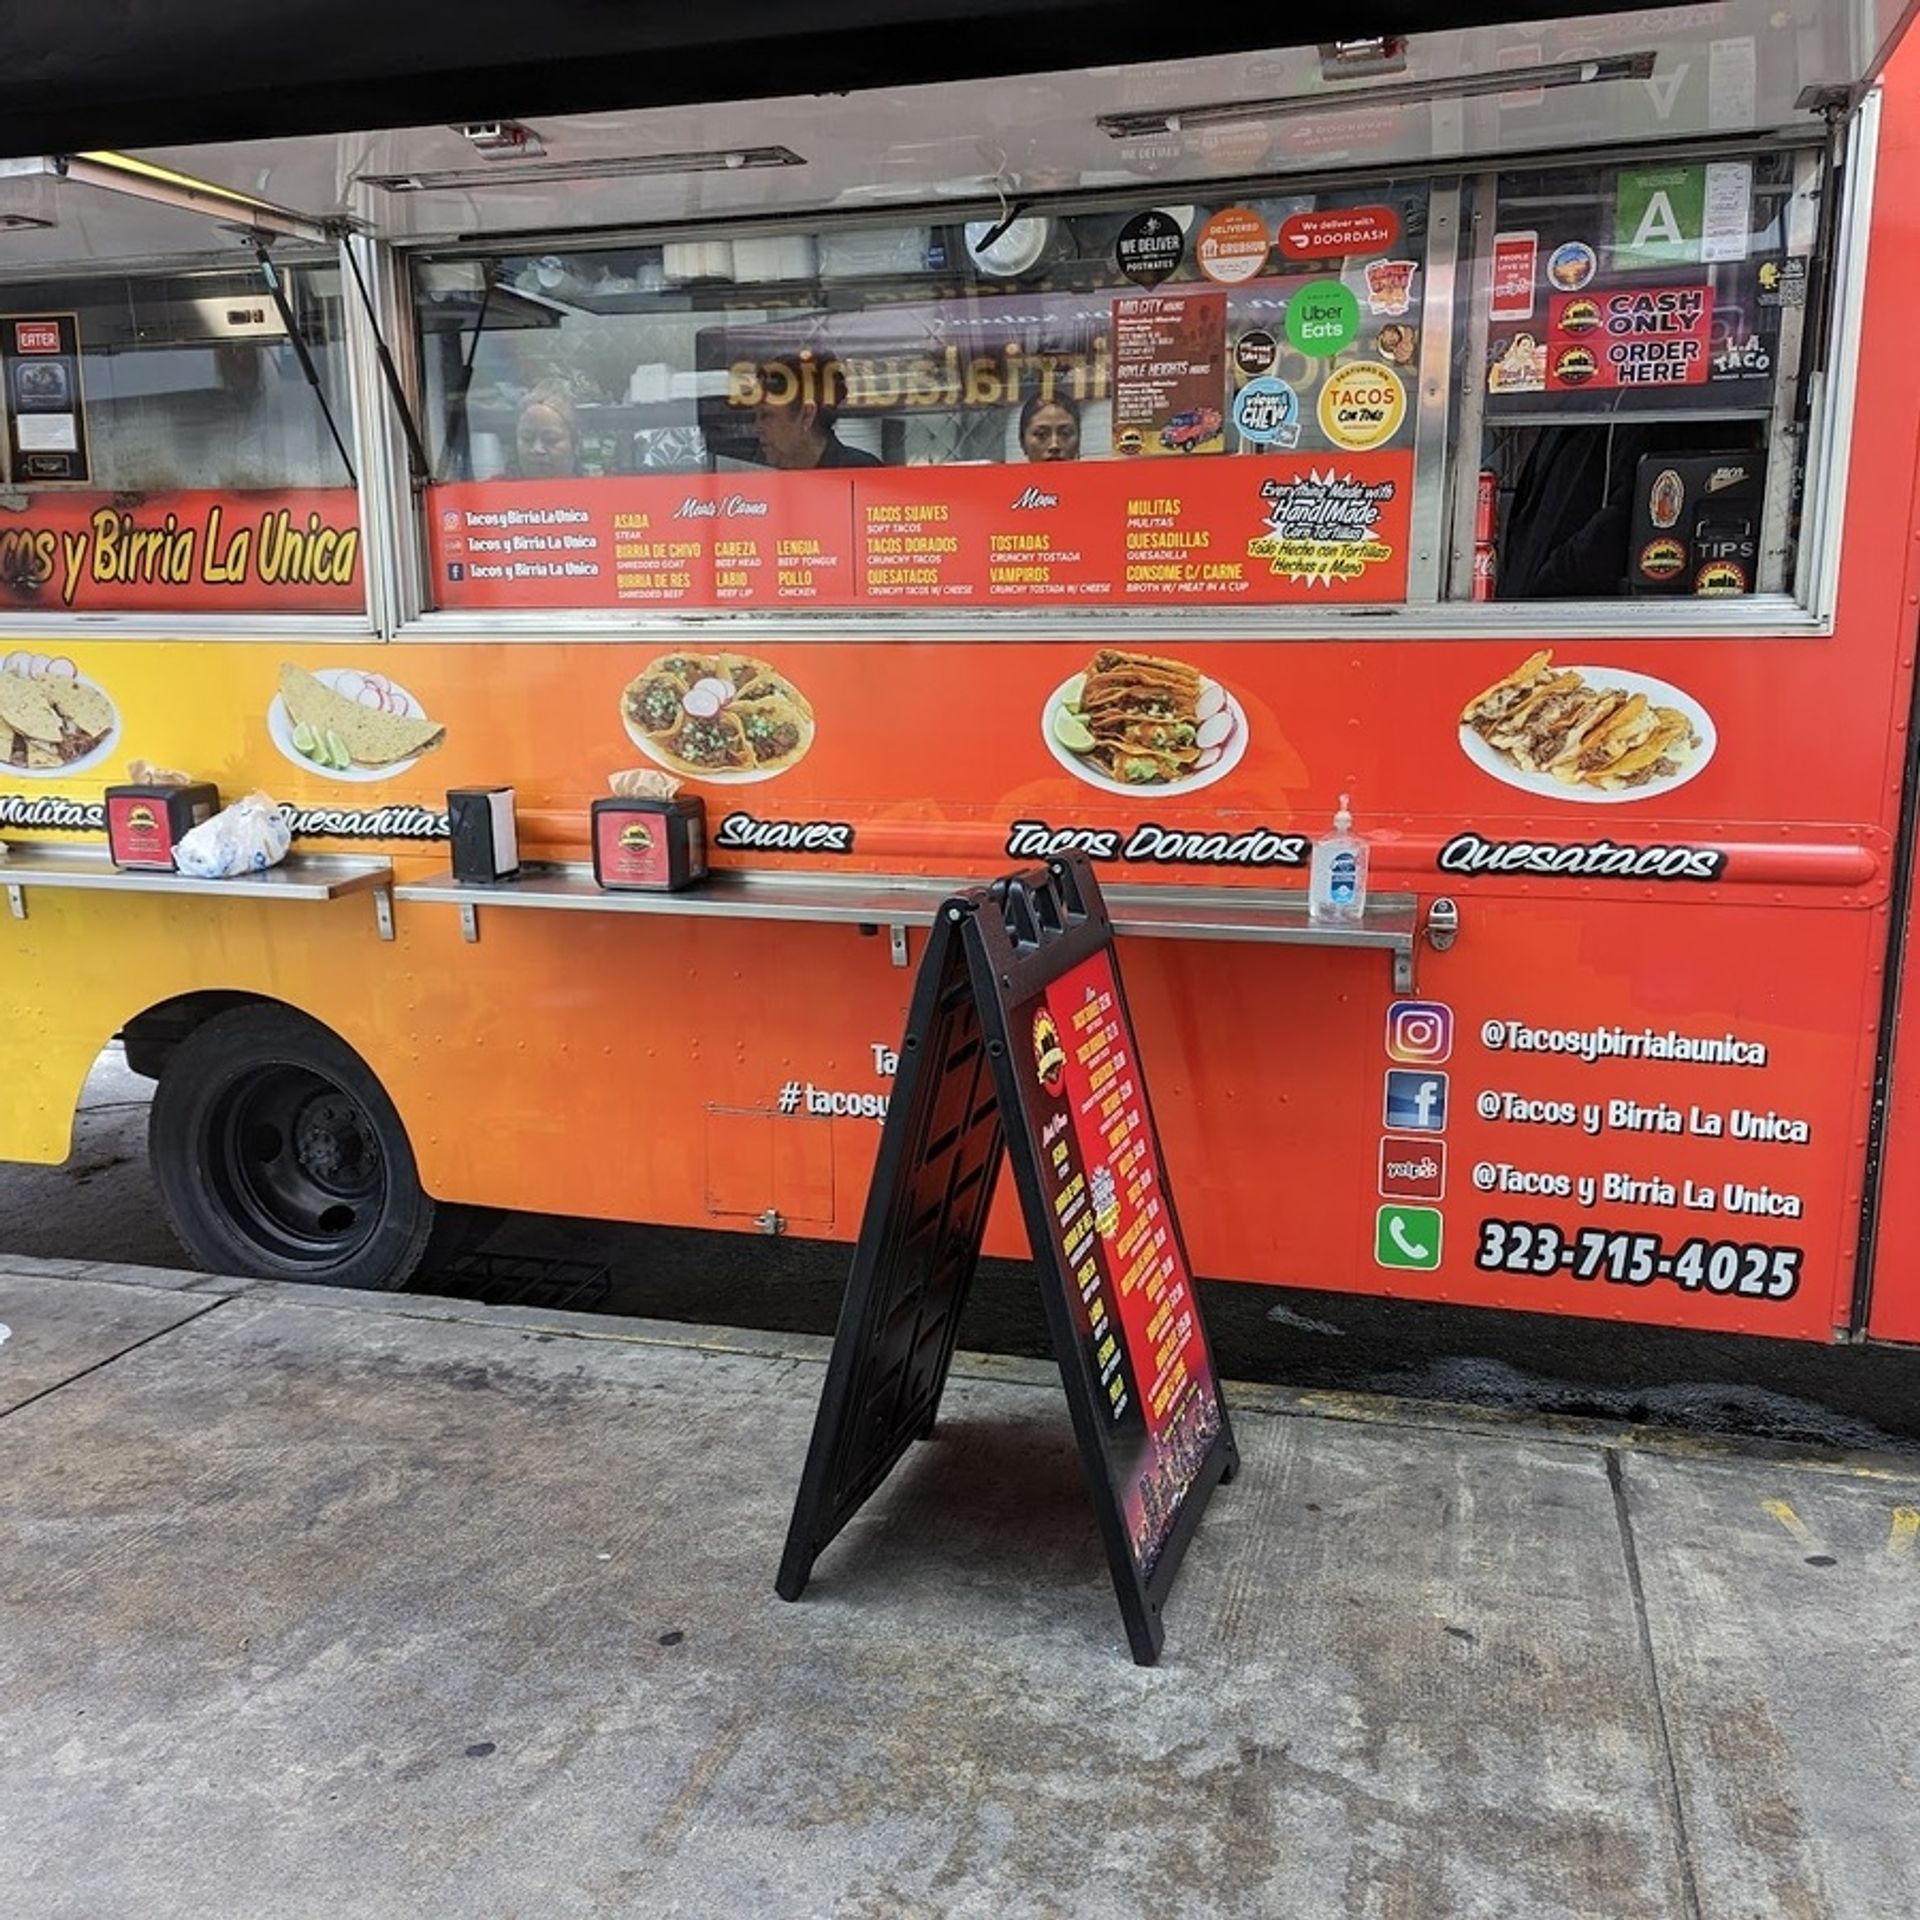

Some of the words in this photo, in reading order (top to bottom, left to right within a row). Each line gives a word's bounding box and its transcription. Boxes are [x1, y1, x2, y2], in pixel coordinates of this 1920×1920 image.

[1302, 221, 1318, 231] We
[1319, 219, 1353, 230] deliver
[1354, 217, 1376, 227] with
[1631, 191, 1683, 249] A
[1209, 222, 1260, 236] DELIVERED
[1120, 239, 1136, 254] WE
[1138, 235, 1180, 252] DELIVER
[1313, 230, 1389, 245] DOORDASH
[1127, 259, 1174, 272] POSTMATES
[1607, 290, 1704, 314] CASH
[1302, 305, 1343, 321] Uber
[1302, 322, 1343, 338] Eats
[1607, 311, 1704, 335] ONLY
[21, 333, 57, 347] EATER
[1607, 340, 1700, 364] ORDER
[1148, 361, 1189, 376] HEIGHTS
[1713, 351, 1770, 372] TACO
[1618, 362, 1686, 385] HERE
[1329, 388, 1395, 406] TACOS
[1261, 480, 1326, 499] Everything
[1012, 487, 1059, 510] Menu
[866, 506, 902, 522] TACOS
[905, 505, 949, 521] SUAVES
[1127, 499, 1182, 516] MULITAS
[614, 513, 650, 529] ASADA
[867, 523, 891, 533] SOFT
[892, 523, 922, 533] TACOS
[1127, 517, 1175, 528] MULITAS
[615, 531, 642, 540] STEAK
[990, 535, 1050, 551] TOSTADAS
[1126, 531, 1210, 549] QUESADILLAS
[468, 537, 501, 552] Tacos
[503, 540, 512, 554] y
[513, 536, 546, 551] Birria
[547, 536, 563, 549] La
[563, 534, 597, 549] Unica
[616, 543, 651, 559] BIRRIA
[653, 543, 667, 558] DE
[669, 542, 702, 558] CHIVO
[714, 541, 758, 557] CABEZA
[776, 540, 821, 556] LENGUA
[867, 538, 902, 554] TACOS
[905, 537, 958, 553] DORADOS
[1249, 540, 1277, 554] Todo
[1279, 541, 1315, 557] Hecho
[1339, 543, 1391, 559] Tortillas
[1698, 541, 1754, 558] TIPS
[63, 532, 88, 606] y
[91, 507, 197, 585] Birria
[202, 506, 251, 584] La
[256, 508, 361, 585] Unica
[715, 559, 736, 568] BEEF
[737, 558, 762, 567] HEAD
[778, 557, 799, 567] BEEF
[800, 556, 838, 566] TONGUE
[867, 555, 911, 565] CRUNCHY
[912, 554, 942, 564] TACOS
[990, 553, 1035, 563] CRUNCHY
[1036, 552, 1081, 562] TOSTADA
[1126, 550, 1188, 560] QUESADILLA
[470, 563, 503, 578] Tacos
[505, 566, 514, 581] y
[514, 562, 548, 577] Birria
[549, 563, 564, 576] La
[565, 562, 599, 576] Unica
[616, 560, 660, 570] SHREDDED
[661, 559, 686, 569] GOAT
[1126, 564, 1183, 581] CONSOME
[1184, 564, 1201, 580] C/
[1203, 563, 1243, 580] CARNE
[1273, 557, 1317, 573] Hechas
[1318, 562, 1327, 573] a
[617, 573, 653, 588] BIRRIA
[654, 573, 669, 588] DE
[670, 572, 691, 588] RES
[716, 571, 748, 587] LABIO
[778, 570, 813, 586] POLLO
[868, 568, 938, 584] QUESATACOS
[990, 567, 1050, 583] VAMPIROS
[618, 589, 662, 599] SHREDDED
[663, 589, 684, 598] BEEF
[716, 589, 737, 598] BEEF
[738, 588, 753, 597] LIP
[778, 587, 817, 597] CHICKEN
[868, 586, 904, 596] CRUNCHY
[905, 585, 931, 595] TACOS
[943, 584, 974, 595] CHEESE
[990, 585, 1028, 595] CRUNCHY
[1029, 584, 1066, 594] TOSTADA
[1079, 583, 1112, 594] CHEESE
[1126, 582, 1160, 593] BROTH
[1161, 582, 1176, 594] W/
[1177, 582, 1204, 592] MEAT
[1205, 582, 1217, 592] IN
[1218, 582, 1226, 591] A
[1228, 581, 1250, 592] CUP
[718, 816, 850, 852] Suaves
[1008, 822, 1117, 858] Tacos
[1125, 826, 1305, 864] Dorados
[1440, 836, 1721, 877] Quesatacos
[1480, 1019, 1768, 1066] @Tacosybirrialaunica
[1476, 1089, 1576, 1125] @Tacos
[1582, 1103, 1601, 1135] y
[1607, 1099, 1683, 1134] Birria
[1688, 1106, 1723, 1138] La
[1729, 1108, 1810, 1144] Unica
[1472, 1163, 1571, 1197] @Tacos
[1578, 1175, 1596, 1207] y
[1602, 1172, 1676, 1208] Birria
[1682, 1179, 1716, 1211] La
[1721, 1181, 1802, 1219] Unica
[1478, 1222, 1799, 1300] 323-715-4025
